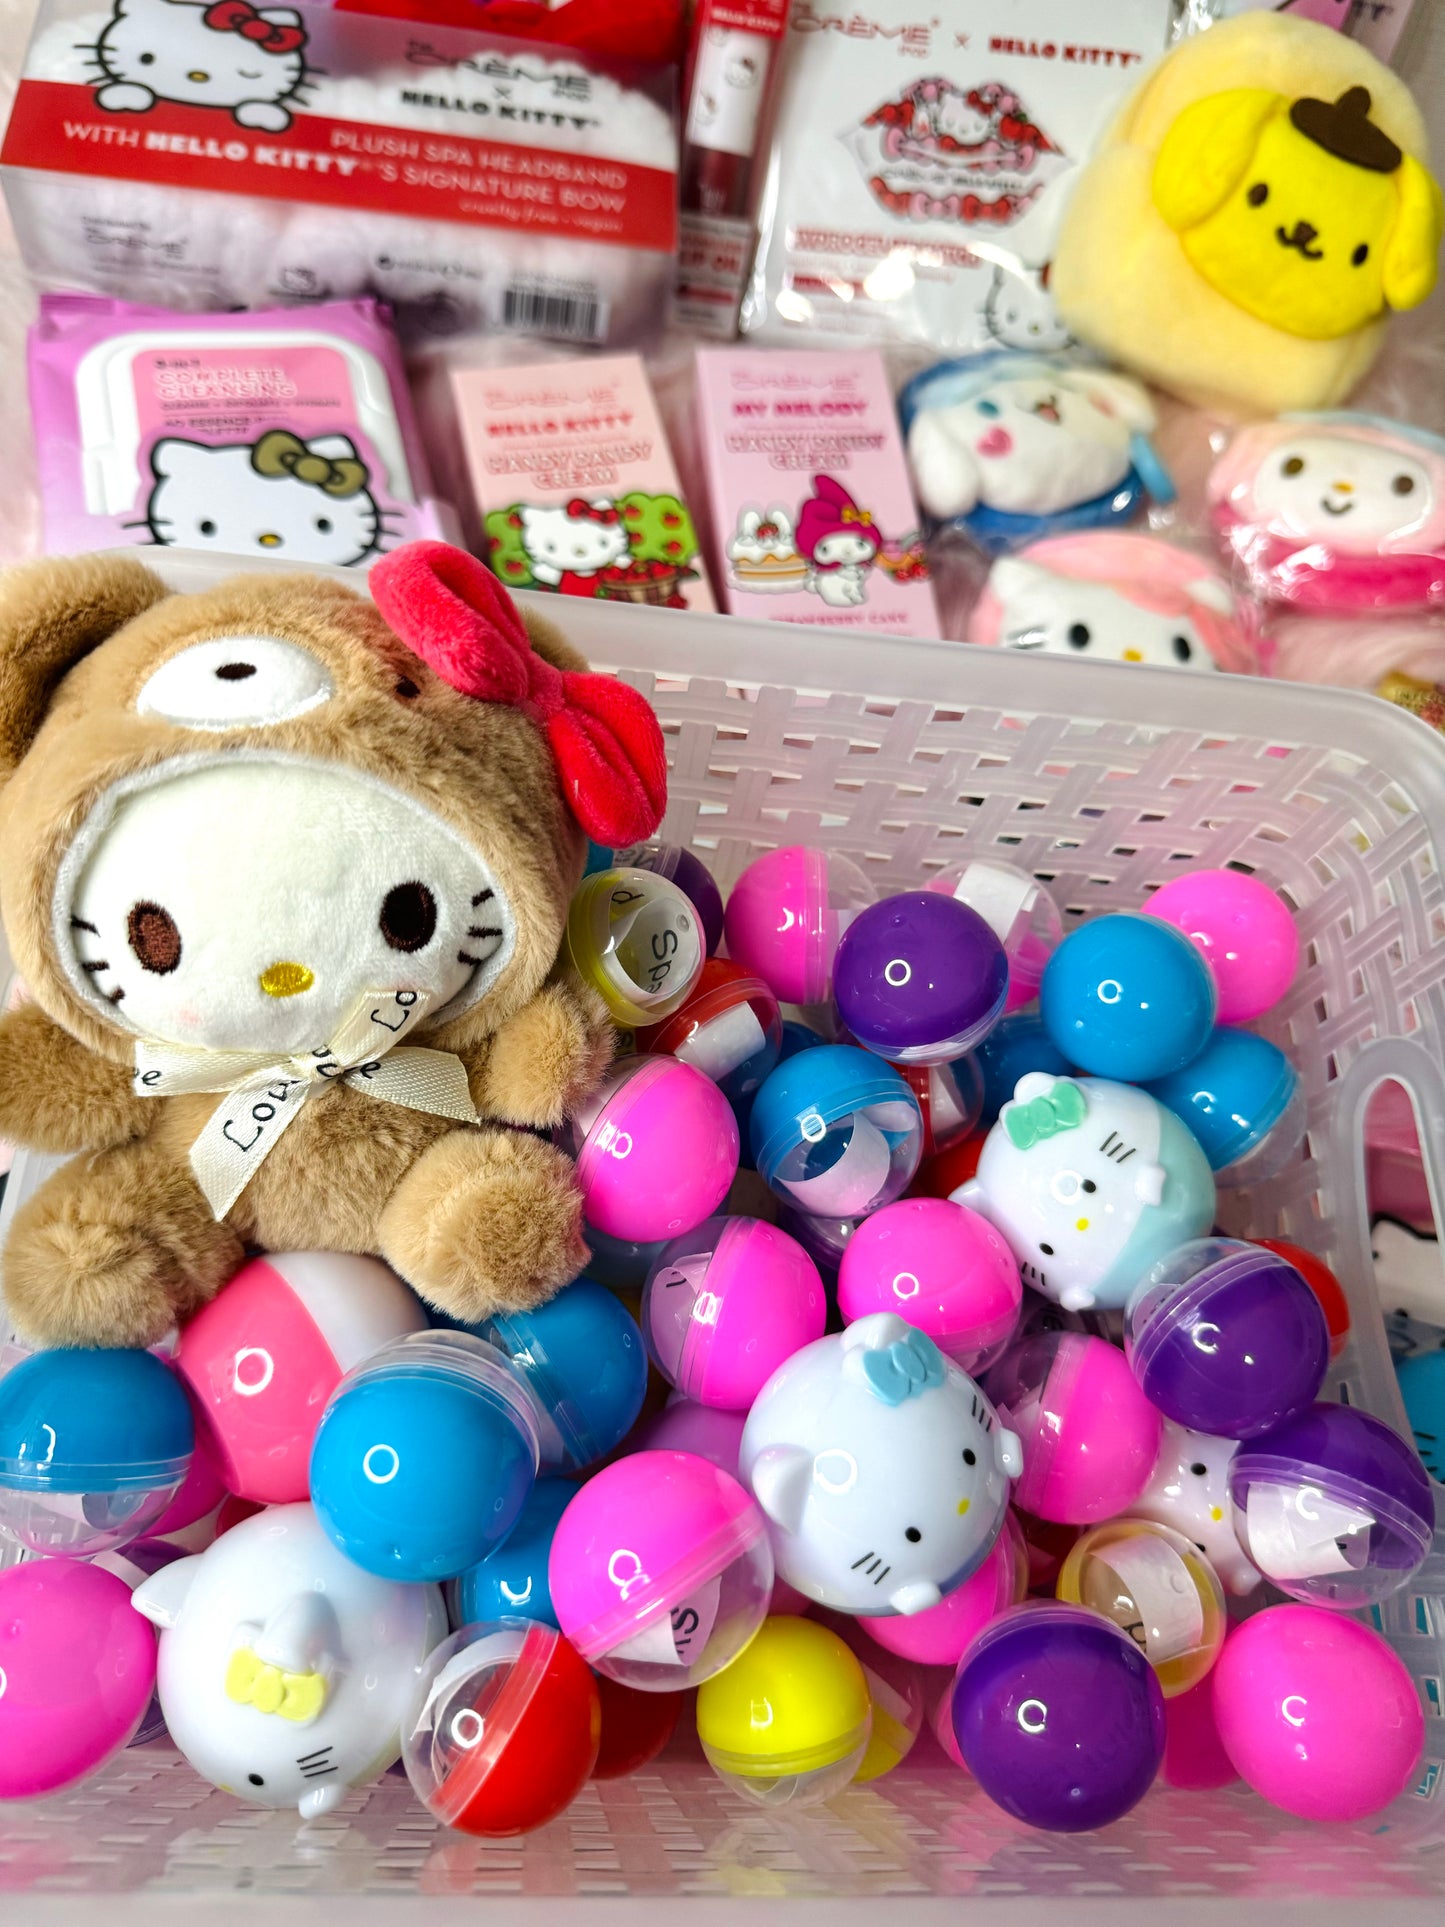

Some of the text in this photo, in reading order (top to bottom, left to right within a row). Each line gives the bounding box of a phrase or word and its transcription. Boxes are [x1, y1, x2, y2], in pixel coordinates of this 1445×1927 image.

[990, 37, 1056, 60] HELLO
[402, 90, 489, 115] HELLO
[63, 121, 140, 148] WITH
[146, 131, 249, 162] HELLO
[402, 163, 555, 204] SIGNATURE
[559, 187, 627, 214] BOW
[330, 128, 628, 190] PLUSH SPA HEADBAND
[158, 382, 297, 399] CLEANSING
[734, 401, 867, 416] MY MELODY
